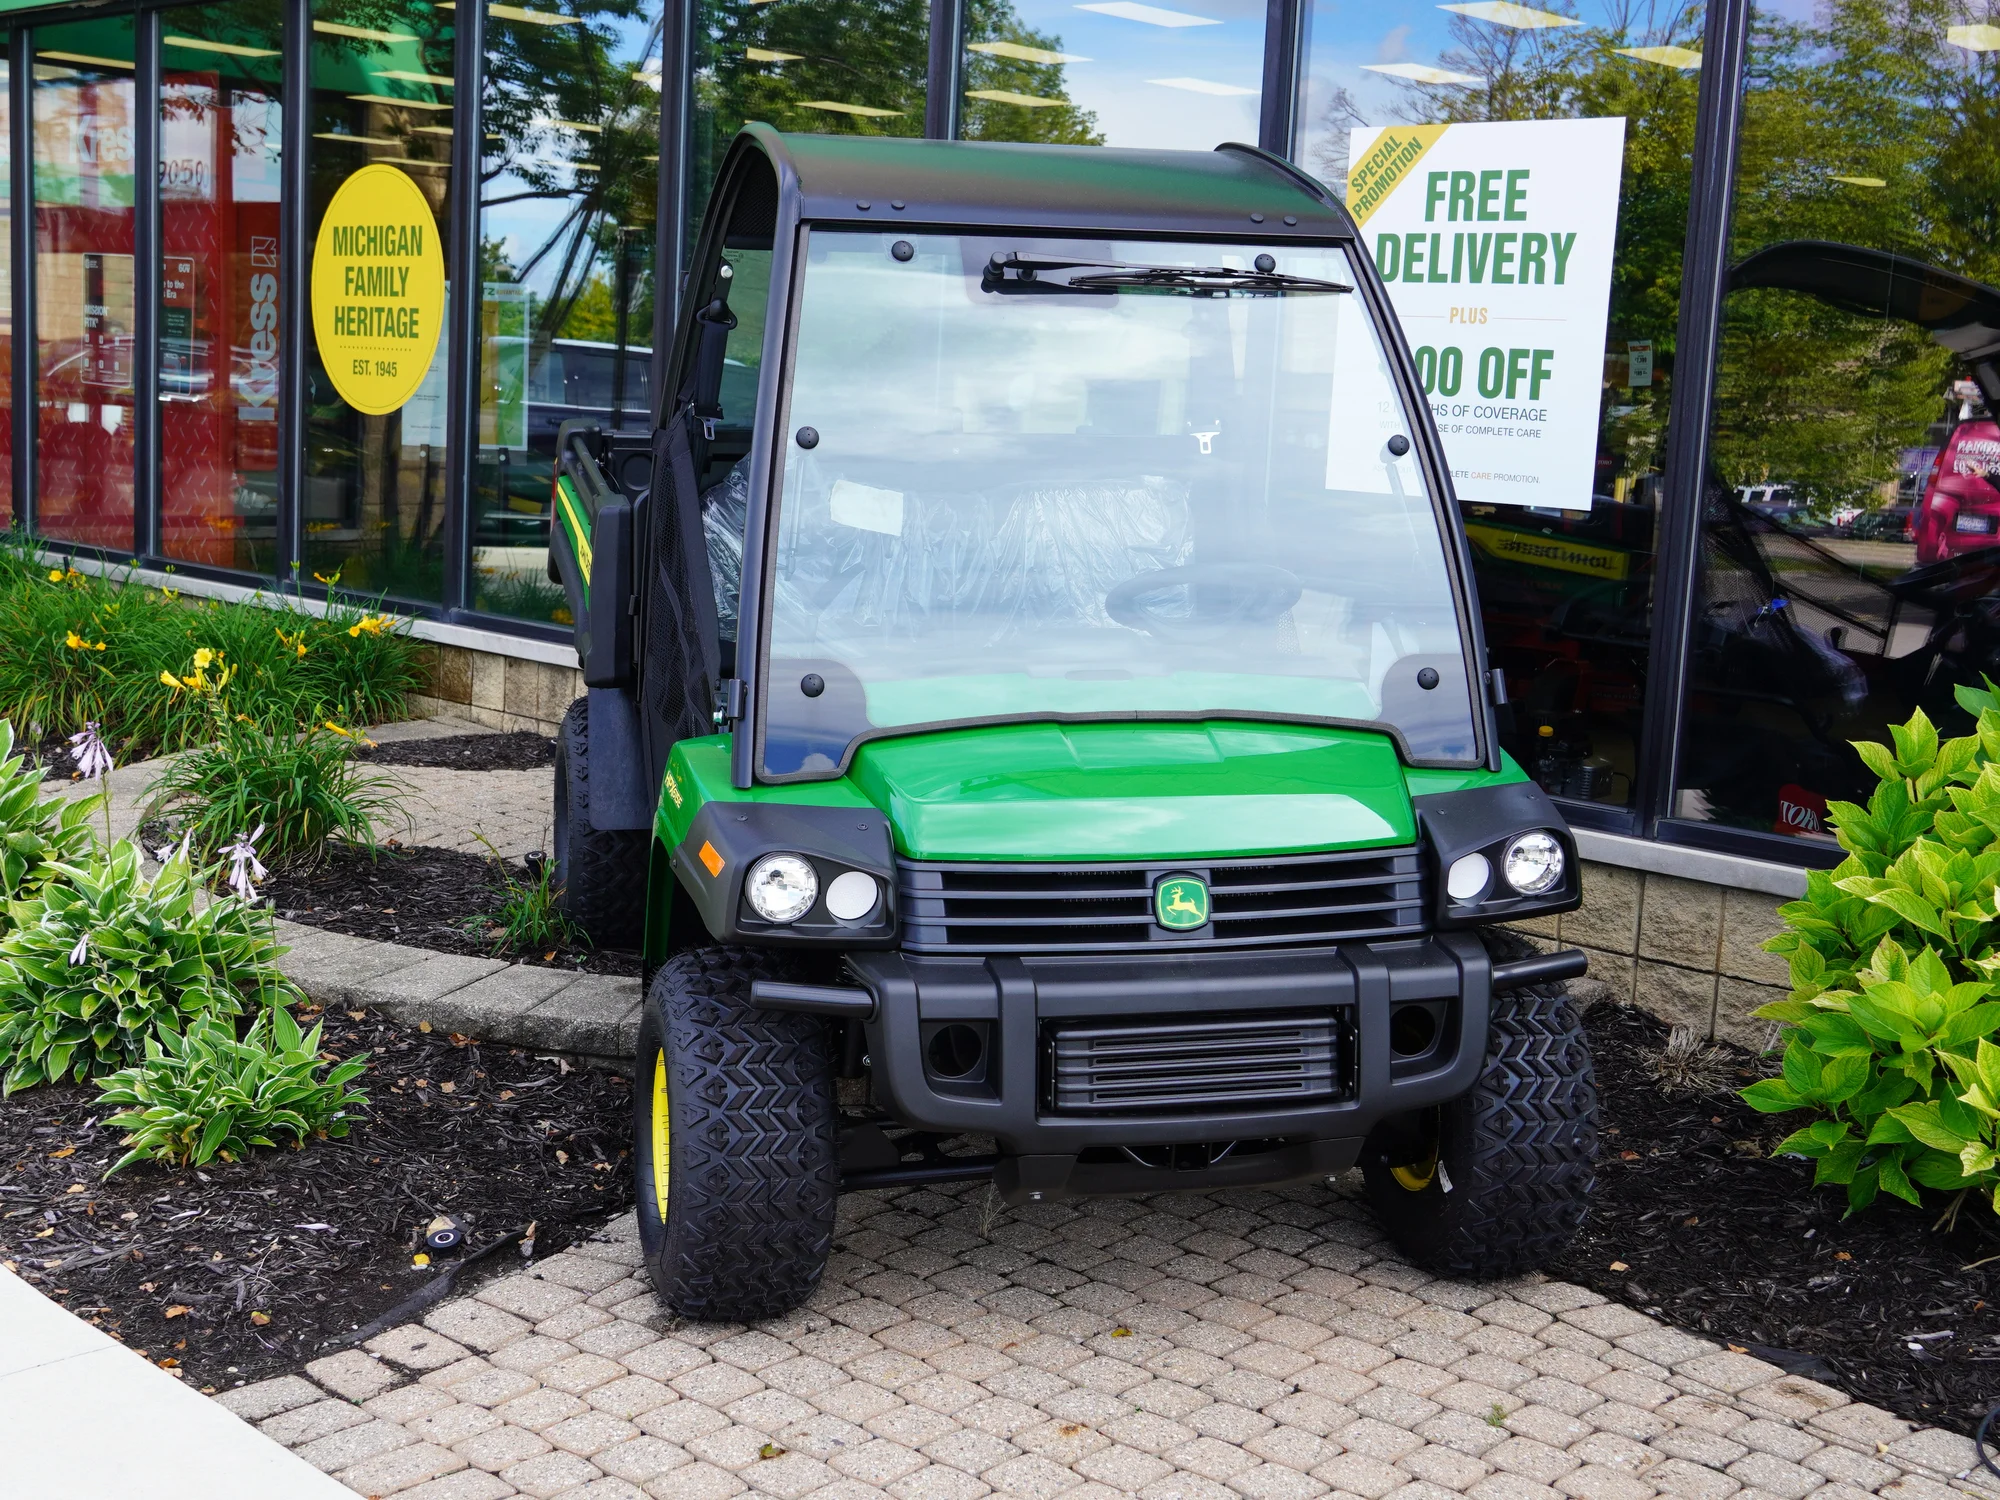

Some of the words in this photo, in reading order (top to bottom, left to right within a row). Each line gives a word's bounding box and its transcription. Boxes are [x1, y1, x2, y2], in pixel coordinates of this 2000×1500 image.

[1351, 135, 1403, 193] SPECIAL
[1352, 136, 1423, 219] PROMOTION
[1424, 169, 1530, 222] FREE
[333, 225, 422, 256] MICHIGAN
[1376, 232, 1577, 285] DELIVERY
[345, 266, 410, 297] FAMILY
[334, 306, 420, 339] HERITAGE
[1449, 307, 1489, 325] PLUS
[238, 273, 278, 421] Kress
[353, 359, 371, 376] EST.
[375, 360, 398, 378] 1945
[1412, 345, 1464, 397] 00
[1477, 347, 1555, 401] OFF
[1452, 404, 1470, 417] OF
[1474, 405, 1548, 422] COVERAGE
[1451, 424, 1464, 433] OF
[1465, 425, 1515, 437] COMPLETE
[1516, 428, 1542, 438] CARE
[1471, 471, 1492, 480] CARE
